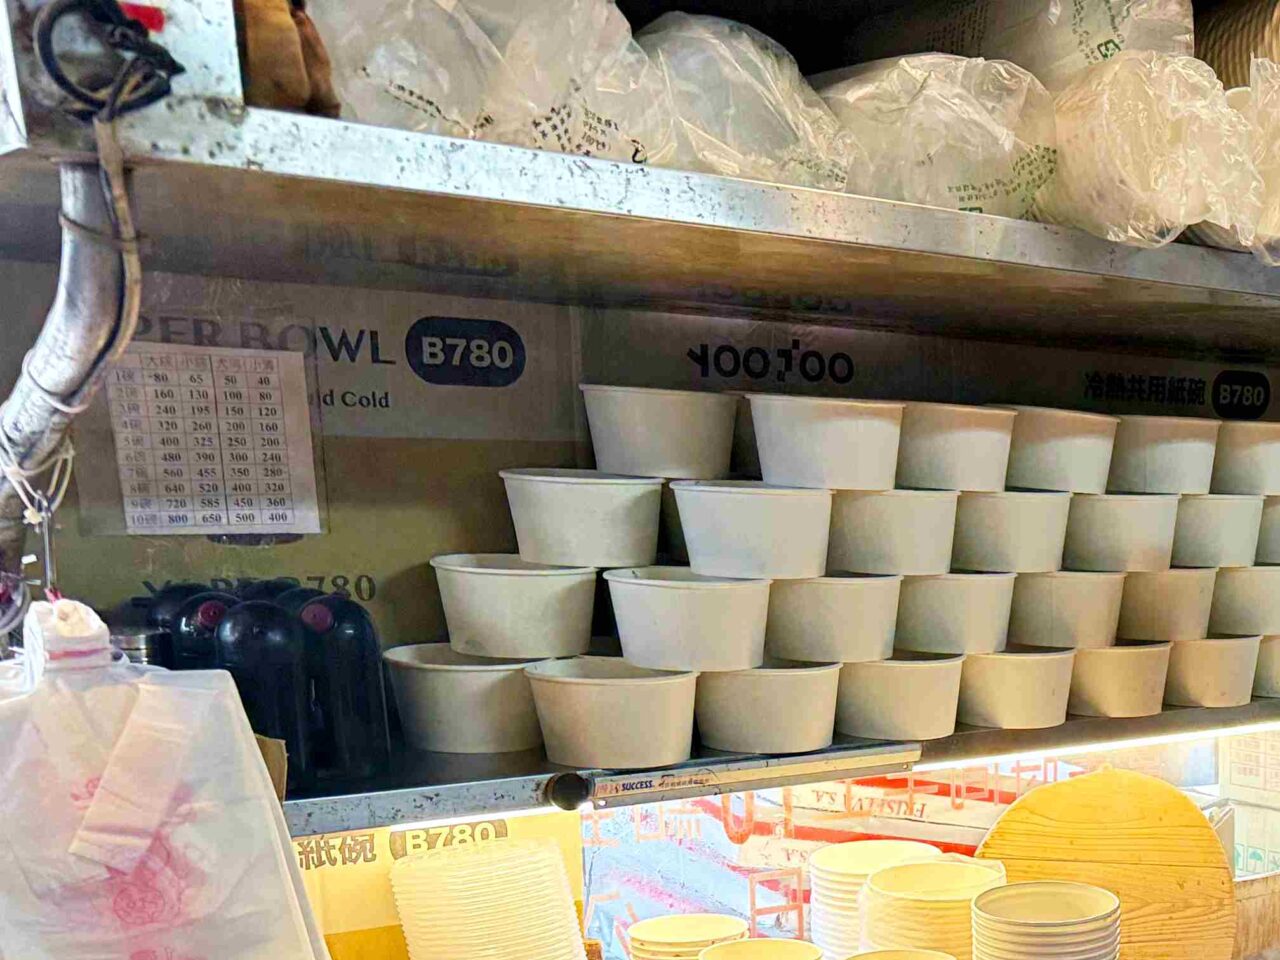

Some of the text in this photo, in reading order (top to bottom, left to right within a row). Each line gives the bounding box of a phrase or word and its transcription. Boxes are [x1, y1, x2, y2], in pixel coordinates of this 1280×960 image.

[421, 336, 515, 370] B780
[189, 375, 203, 384] 65
[224, 375, 237, 385] 50
[257, 377, 270, 386] 40
[153, 389, 174, 399] 160
[189, 391, 208, 400] 130
[223, 391, 242, 401] 100
[259, 392, 272, 401] 80
[341, 391, 391, 409] Cold
[1218, 384, 1265, 408] B780
[156, 405, 176, 416] 240
[191, 406, 210, 415] 195
[225, 406, 244, 416] 150
[258, 407, 277, 417] 120
[158, 421, 178, 431] 320
[192, 422, 212, 431] 260
[226, 422, 245, 432] 200
[259, 422, 278, 432] 160
[159, 436, 179, 446] 400
[193, 437, 213, 446] 325
[227, 437, 246, 446] 250
[261, 437, 280, 447] 200
[161, 452, 181, 462] 480
[195, 453, 215, 462] 390
[229, 453, 248, 462] 300
[262, 453, 281, 462] 240
[163, 468, 183, 478] 560
[196, 468, 217, 477] 455
[230, 468, 250, 477] 350
[263, 468, 283, 477] 280
[165, 484, 184, 494] 640
[199, 483, 218, 493] 520
[232, 483, 252, 493] 400
[265, 483, 284, 492] 320
[166, 499, 187, 509] 720
[200, 498, 220, 508] 585
[233, 498, 253, 507] 450
[267, 498, 286, 507] 360
[168, 514, 188, 524] 800
[202, 513, 222, 523] 650
[235, 513, 255, 523] 500
[268, 513, 288, 523] 400
[298, 821, 496, 870] 紙碗 B780
